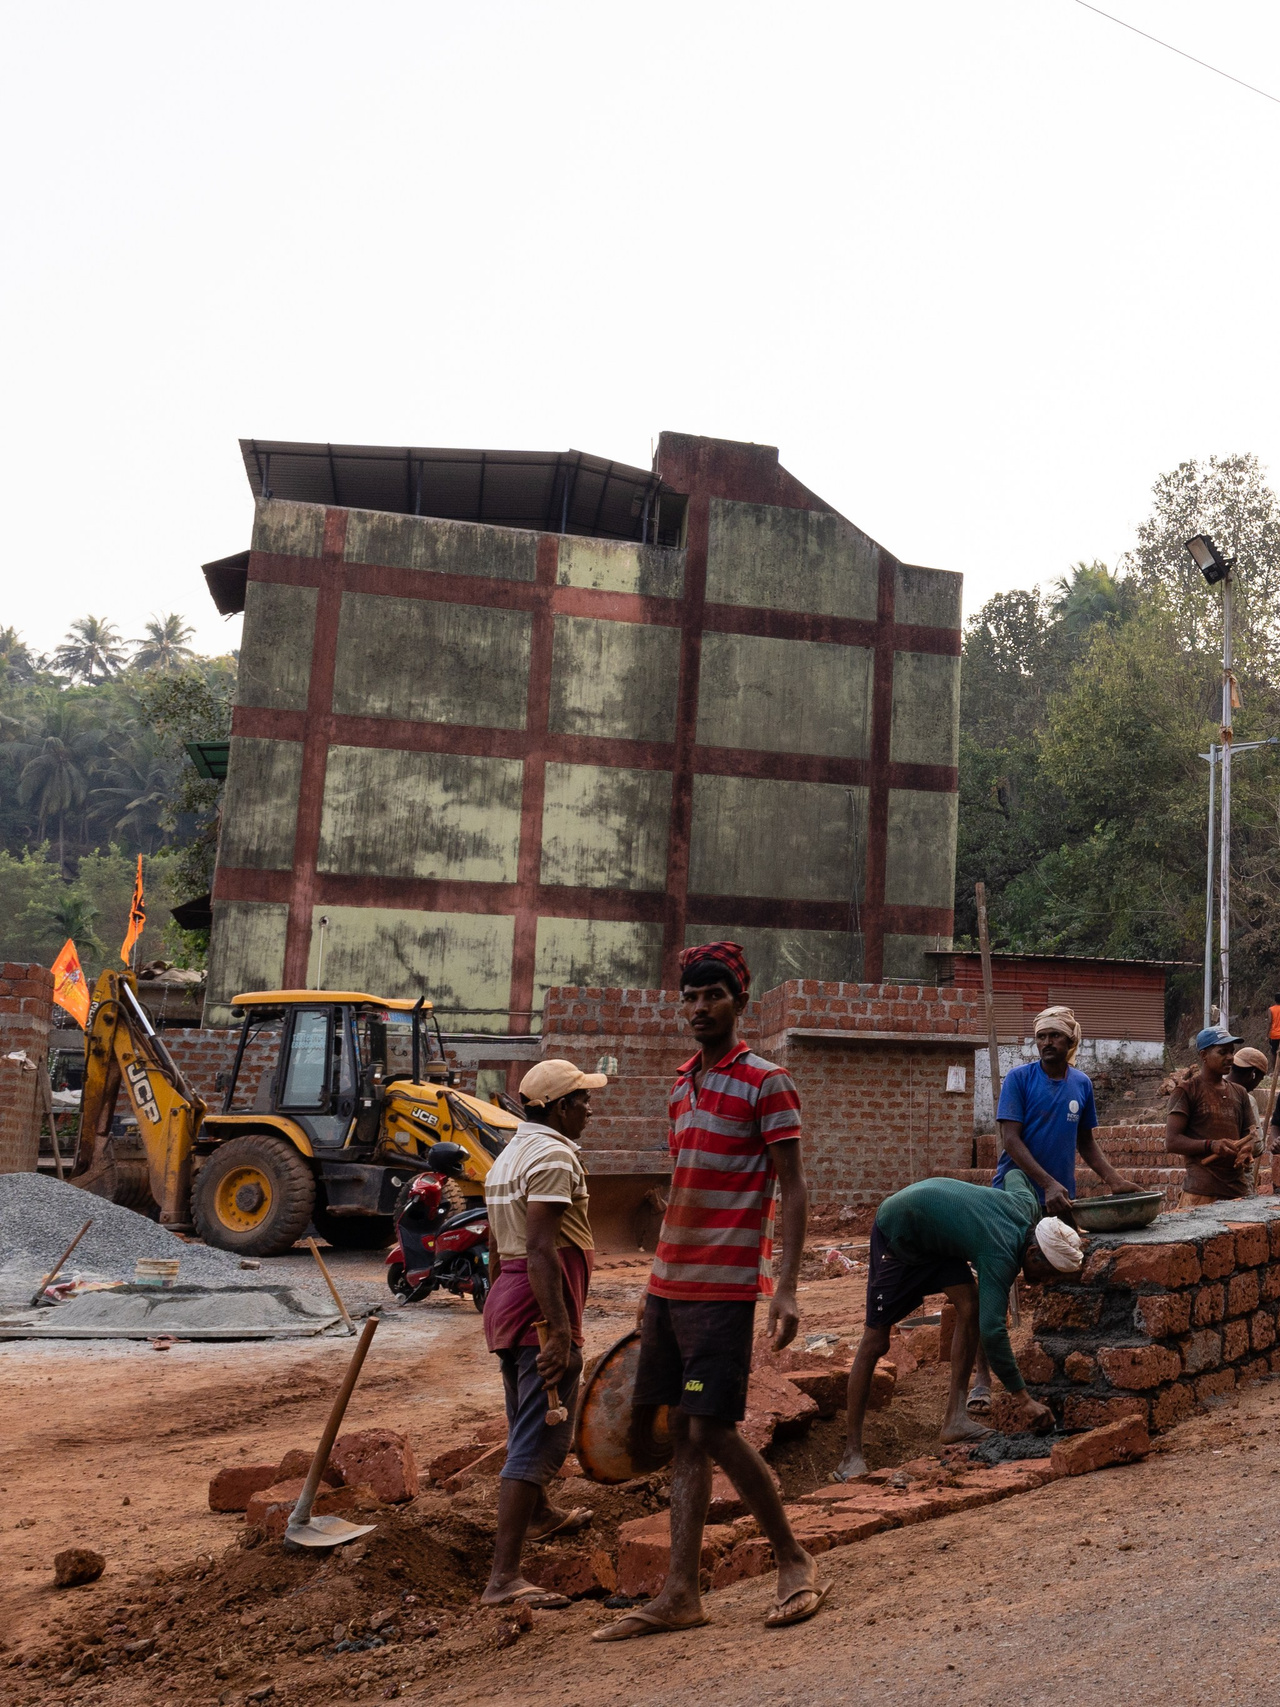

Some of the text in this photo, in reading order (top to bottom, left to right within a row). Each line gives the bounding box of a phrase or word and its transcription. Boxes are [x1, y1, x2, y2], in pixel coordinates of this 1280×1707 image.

[127, 1061, 160, 1123] JCB
[412, 1106, 439, 1126] JCB
[685, 1380, 703, 1391] KTM
